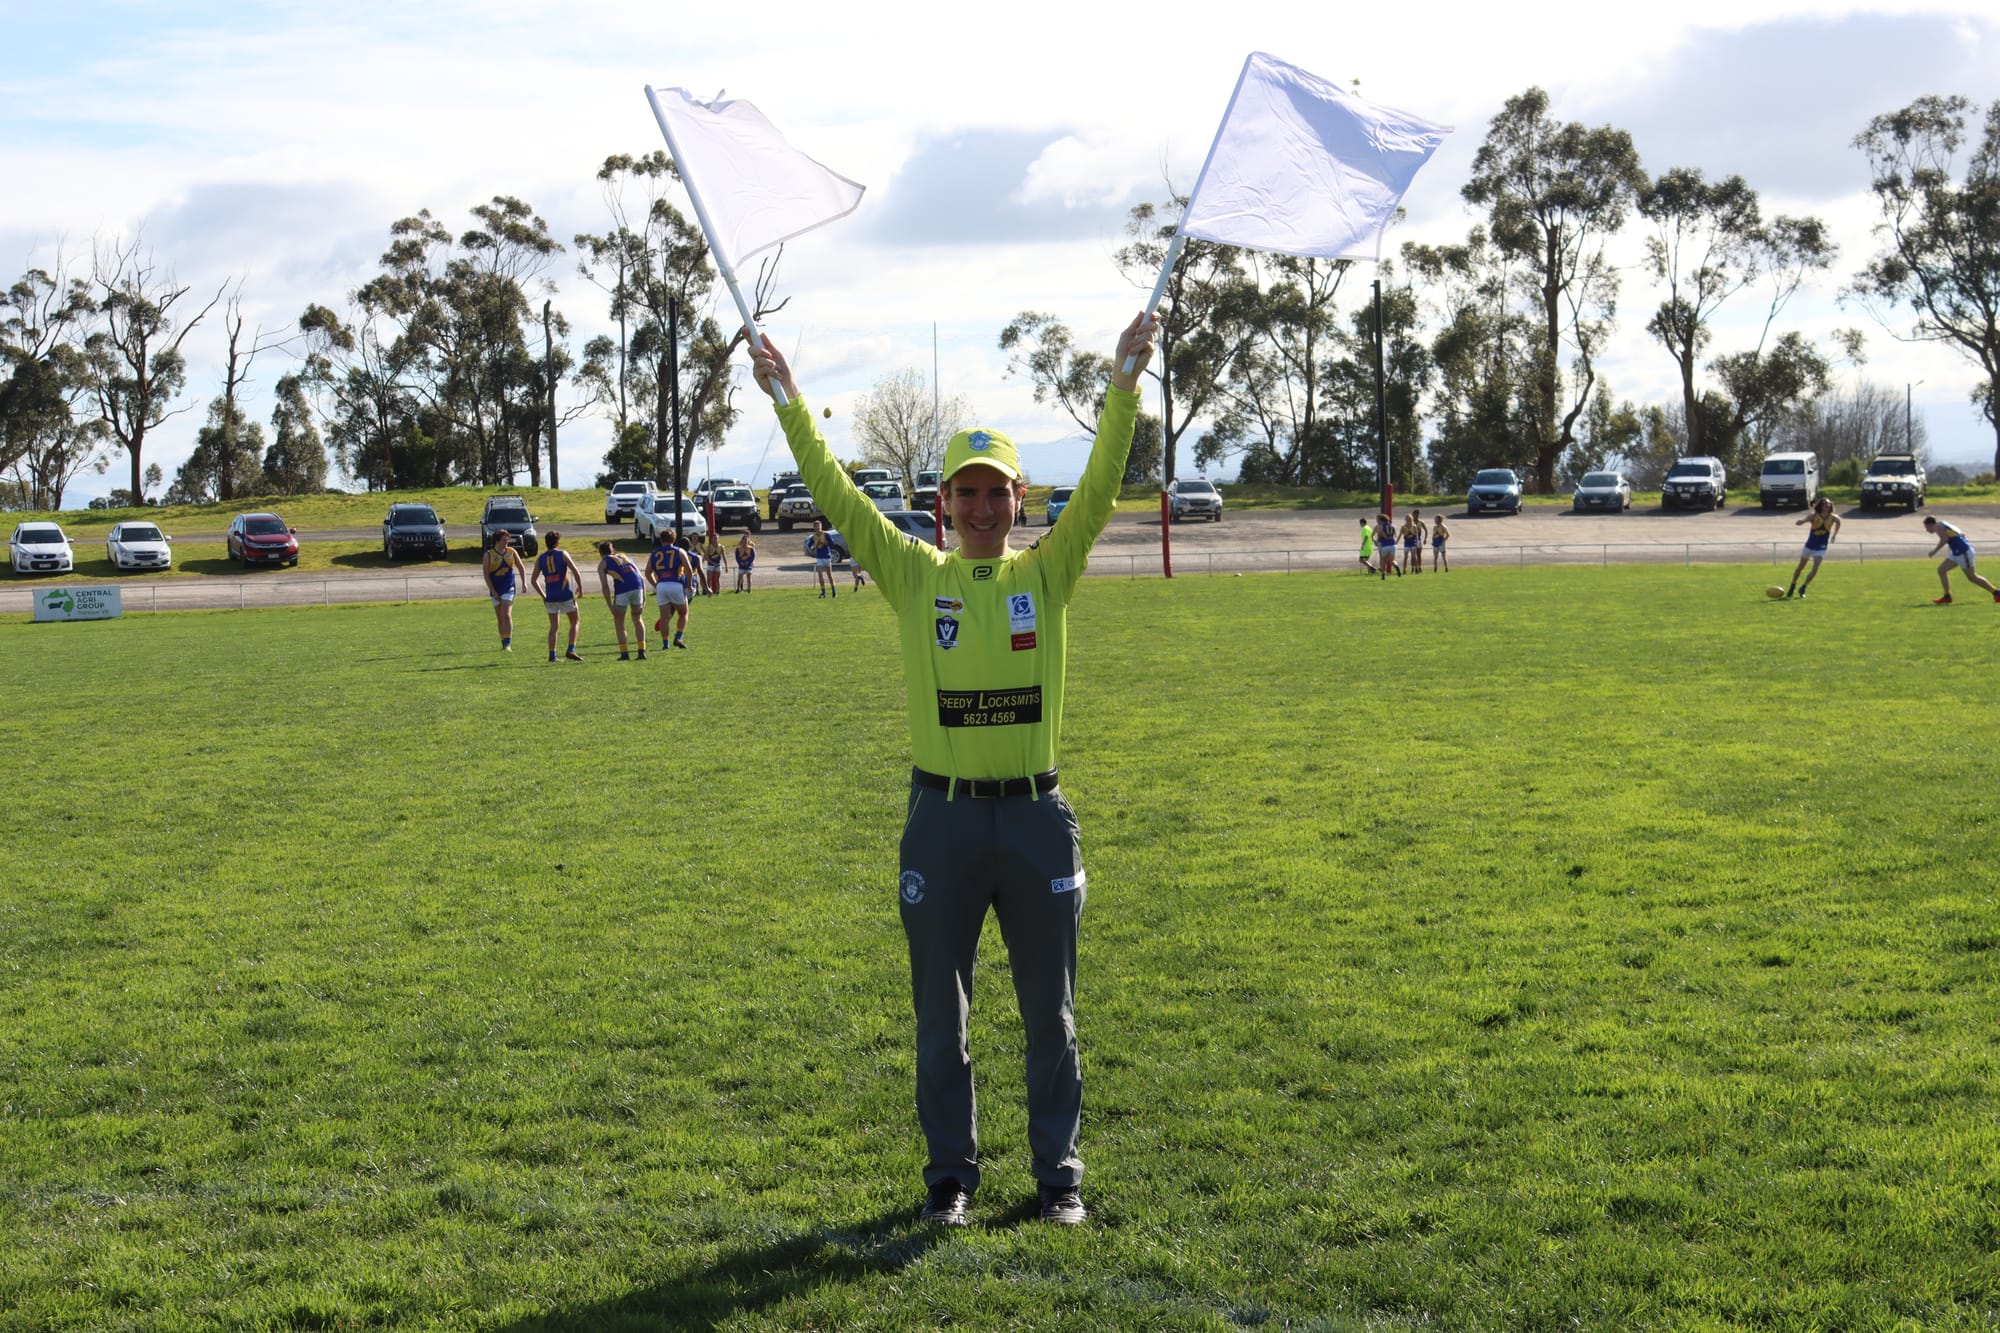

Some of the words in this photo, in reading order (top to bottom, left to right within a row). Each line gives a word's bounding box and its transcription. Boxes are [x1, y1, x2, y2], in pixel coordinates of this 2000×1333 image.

[546, 555, 556, 573] 11
[655, 550, 675, 570] 27
[963, 713, 988, 725] 5623
[990, 711, 1016, 724] 4569
